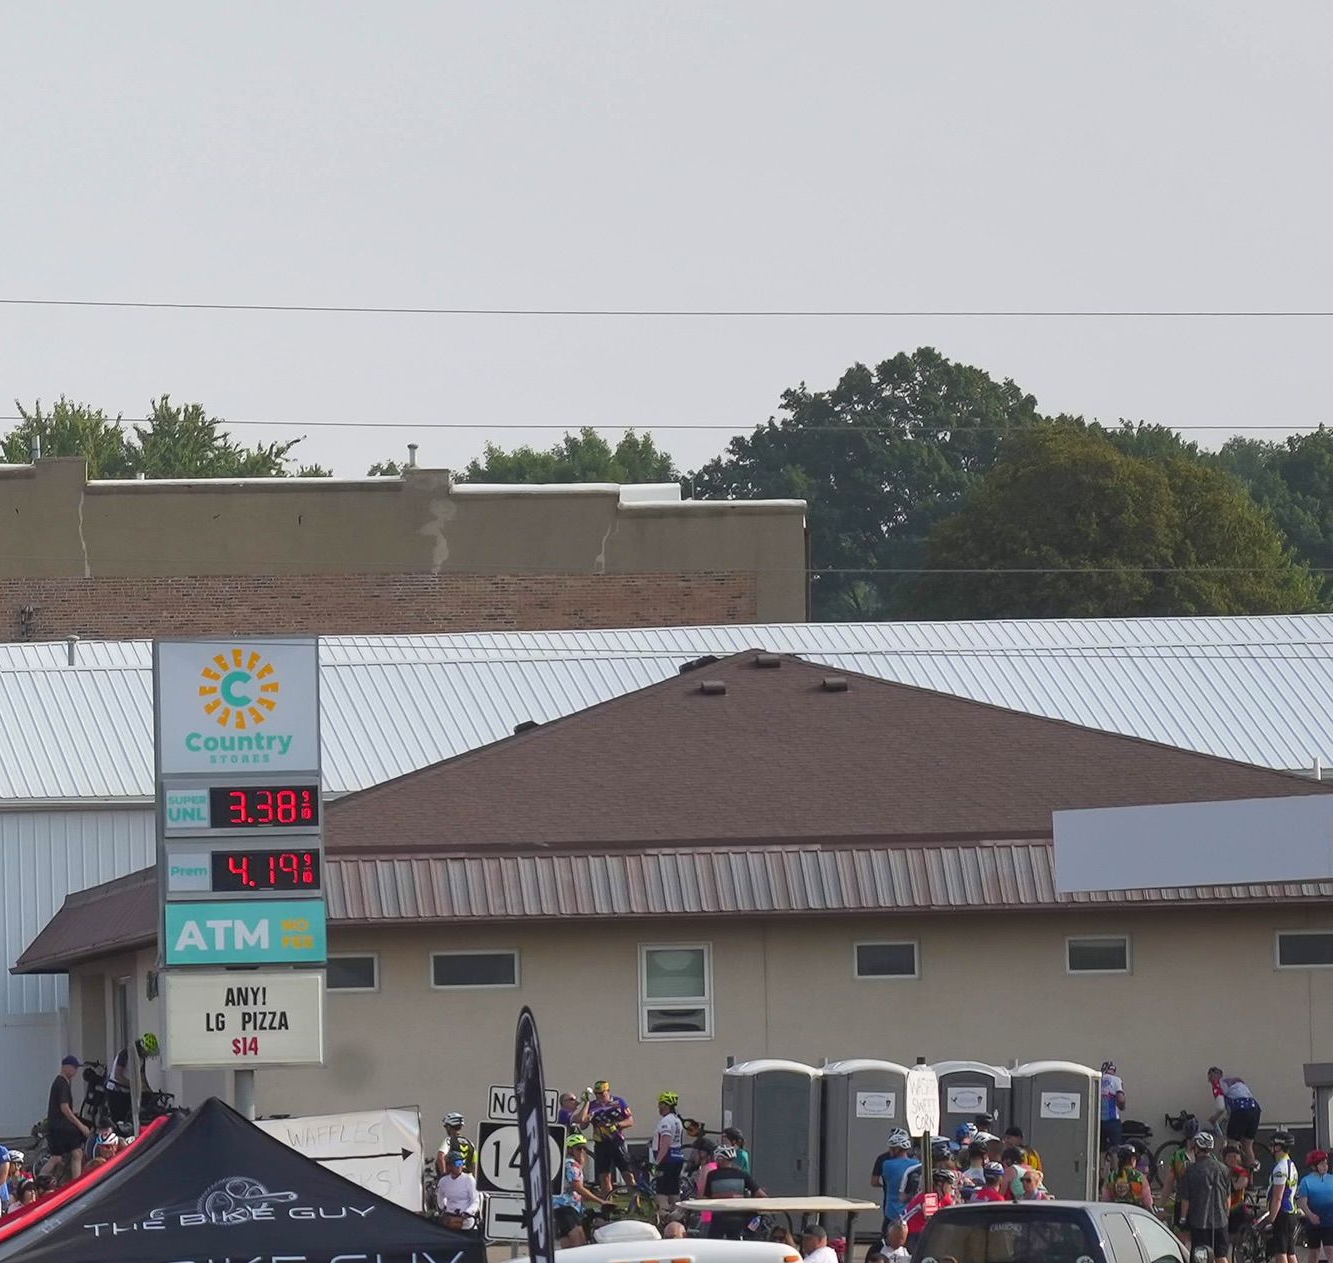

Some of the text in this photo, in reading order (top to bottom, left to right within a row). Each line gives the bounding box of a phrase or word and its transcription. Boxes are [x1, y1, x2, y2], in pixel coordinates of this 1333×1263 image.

[185, 732, 293, 755] Country
[209, 754, 270, 764] STORES
[168, 795, 206, 805] SUPER
[229, 790, 298, 823] 3.38
[168, 806, 207, 822] UNL
[171, 866, 208, 877] Prem
[228, 853, 300, 887] 4.19
[174, 918, 270, 951] ATM
[280, 918, 310, 932] NO
[281, 935, 314, 948] FEE
[225, 987, 267, 1006] ANY!
[205, 1011, 289, 1032] LG PIZZA
[231, 1036, 259, 1056] $14
[492, 1092, 554, 1118] NOH
[287, 1122, 381, 1148] WAFFLES
[83, 1205, 378, 1238] THE BIKE GUY
